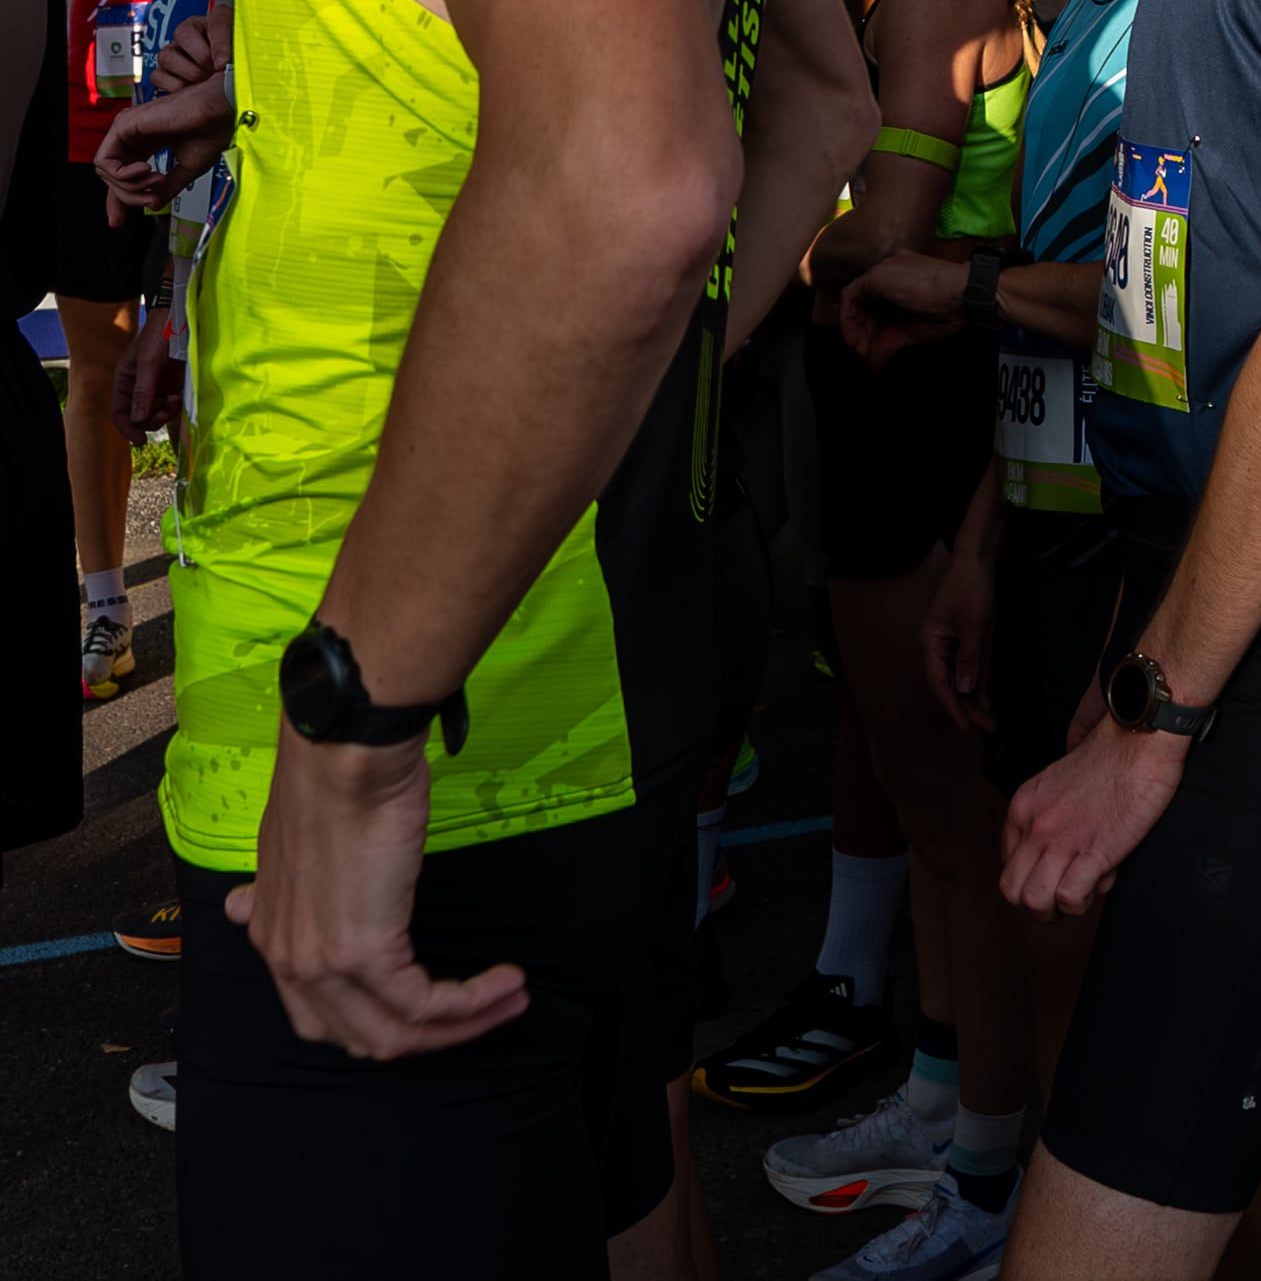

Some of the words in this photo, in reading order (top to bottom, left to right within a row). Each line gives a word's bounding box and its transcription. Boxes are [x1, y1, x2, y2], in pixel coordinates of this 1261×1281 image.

[1161, 218, 1179, 245] 40
[1143, 227, 1153, 300] CONSTRUCTION
[1160, 245, 1179, 269] MIN
[1145, 301, 1155, 325] VINCI
[999, 362, 1046, 426] 9438
